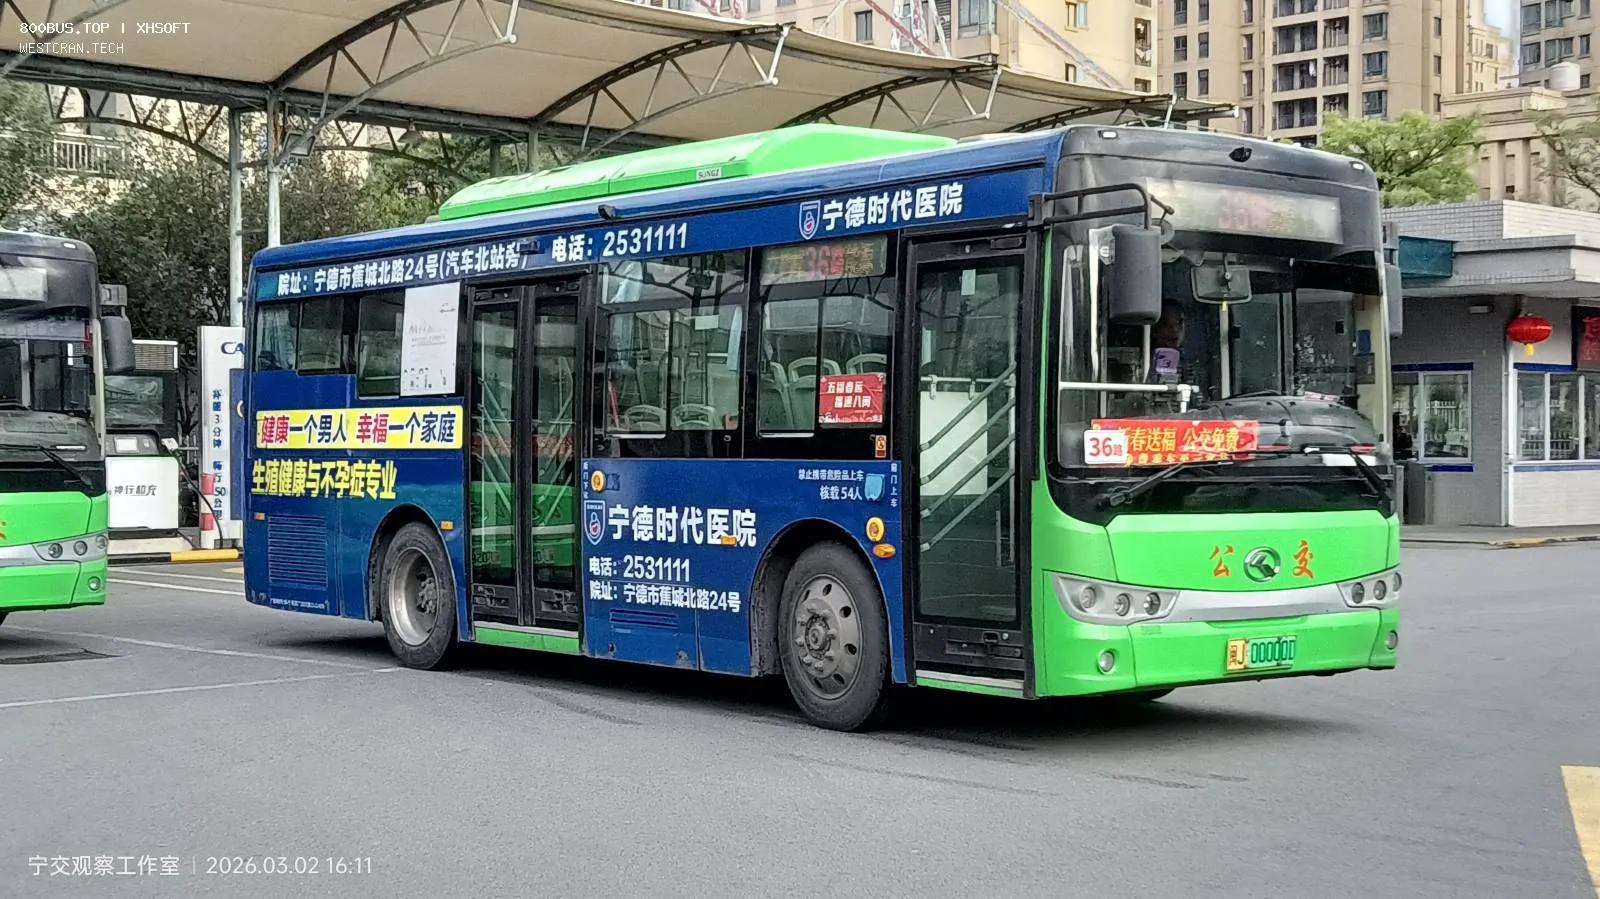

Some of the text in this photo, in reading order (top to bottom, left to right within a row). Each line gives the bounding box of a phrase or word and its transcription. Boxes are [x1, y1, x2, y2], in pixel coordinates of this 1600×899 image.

[822, 182, 964, 231] 宁德时代医院
[551, 222, 688, 262] 电话：2531111
[261, 411, 457, 444] 健康一个男人 幸福一个家庭
[1183, 427, 1240, 452] 公交免费
[1088, 437, 1123, 457] 36路
[251, 458, 398, 500] 生殖健康与不孕症专业
[798, 469, 865, 482] 禁止携带危险品上车
[607, 504, 757, 548] 宁德时代医院
[588, 554, 690, 583] 电话：2531111
